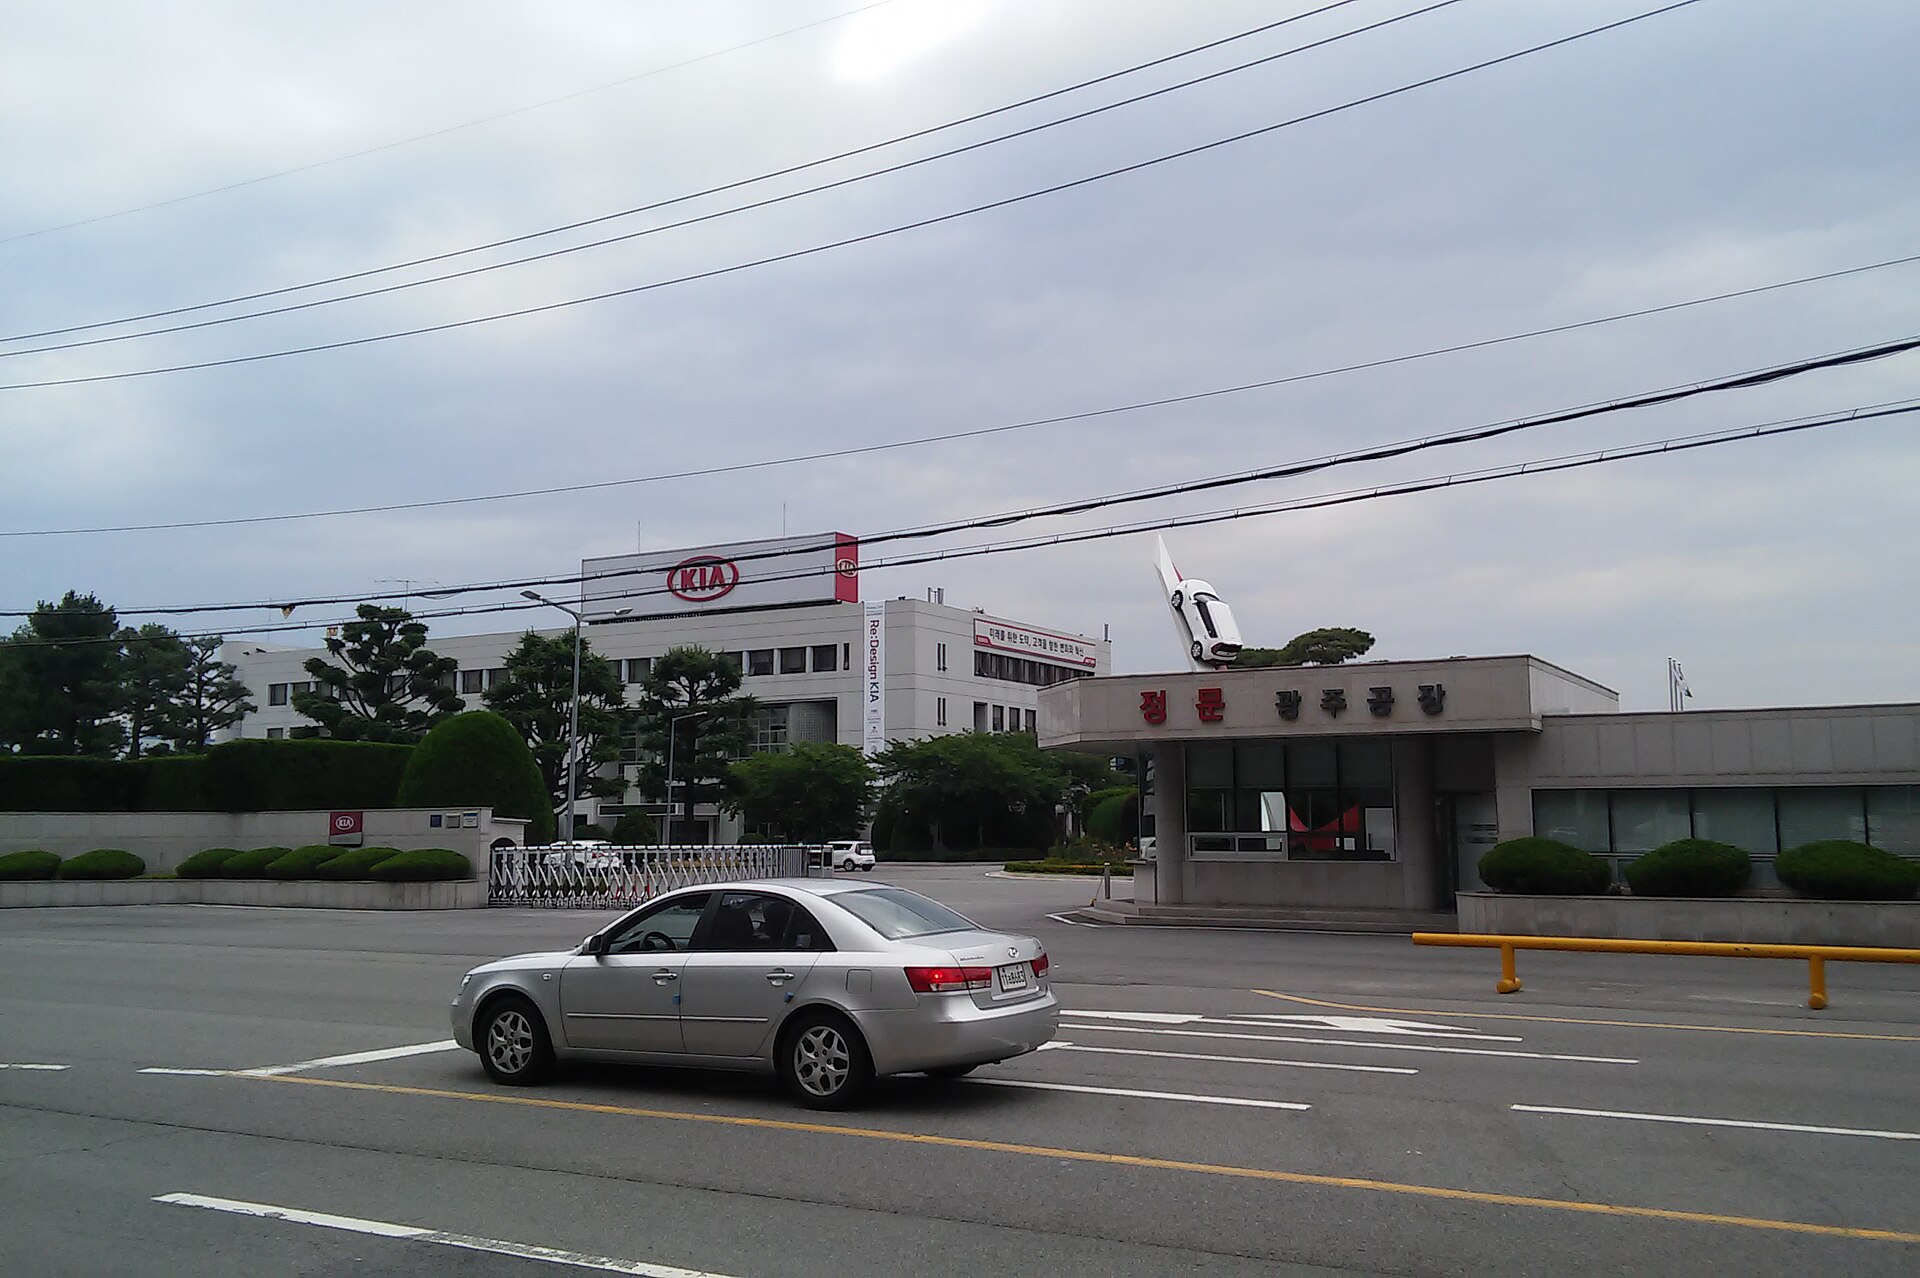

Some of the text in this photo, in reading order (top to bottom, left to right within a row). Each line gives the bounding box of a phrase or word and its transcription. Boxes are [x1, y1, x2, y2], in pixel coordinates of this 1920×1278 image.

[681, 566, 725, 592] KIA
[868, 619, 879, 680] Re:Design
[870, 682, 880, 703] KIA
[1139, 684, 1447, 724] 정문 광주공장
